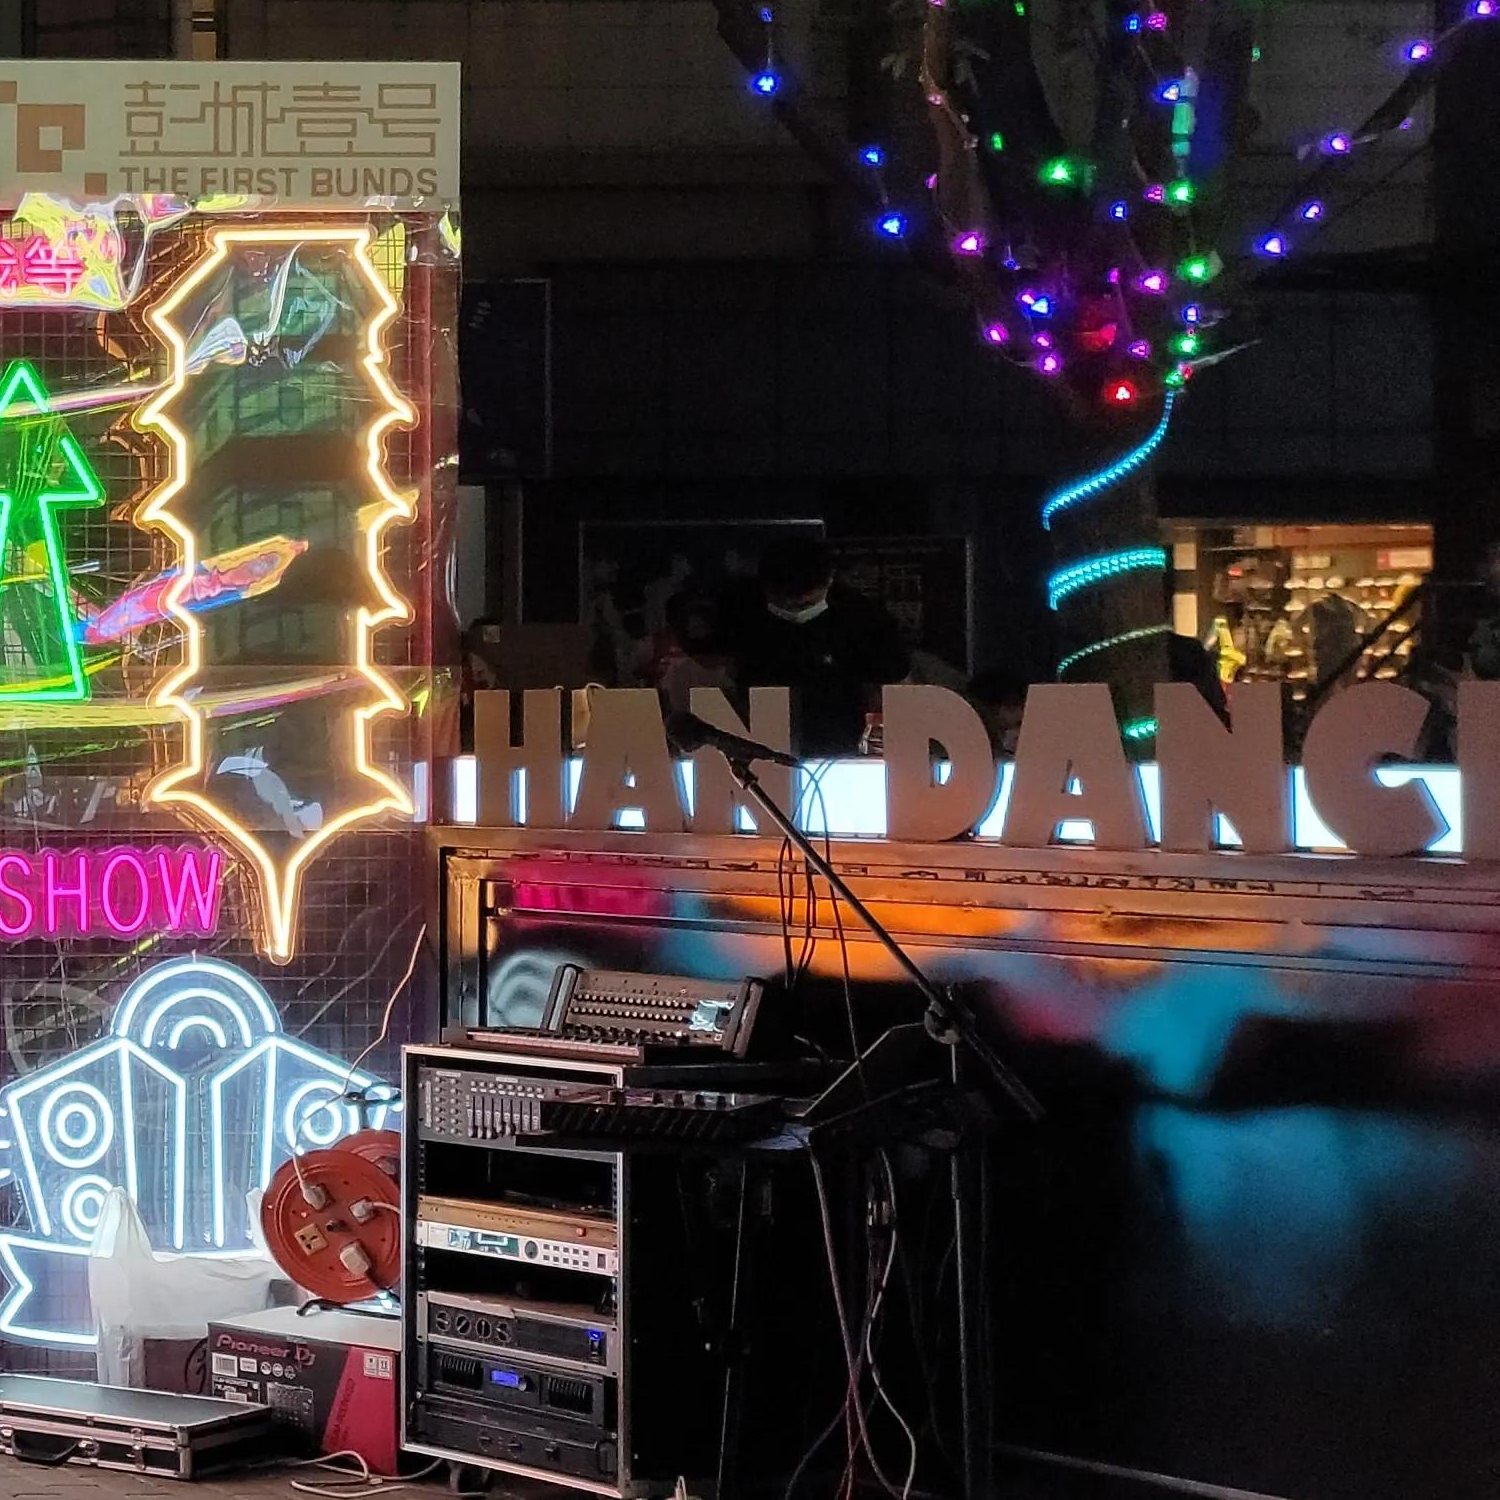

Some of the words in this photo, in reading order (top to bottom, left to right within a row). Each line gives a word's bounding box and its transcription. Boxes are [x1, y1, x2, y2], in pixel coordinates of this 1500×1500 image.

[119, 167, 189, 198] THE
[201, 167, 298, 198] FIRST
[310, 167, 439, 198] BUNDS
[473, 685, 793, 838] HAN
[881, 679, 1500, 862] DANC
[216, 1333, 291, 1358] Pioneer
